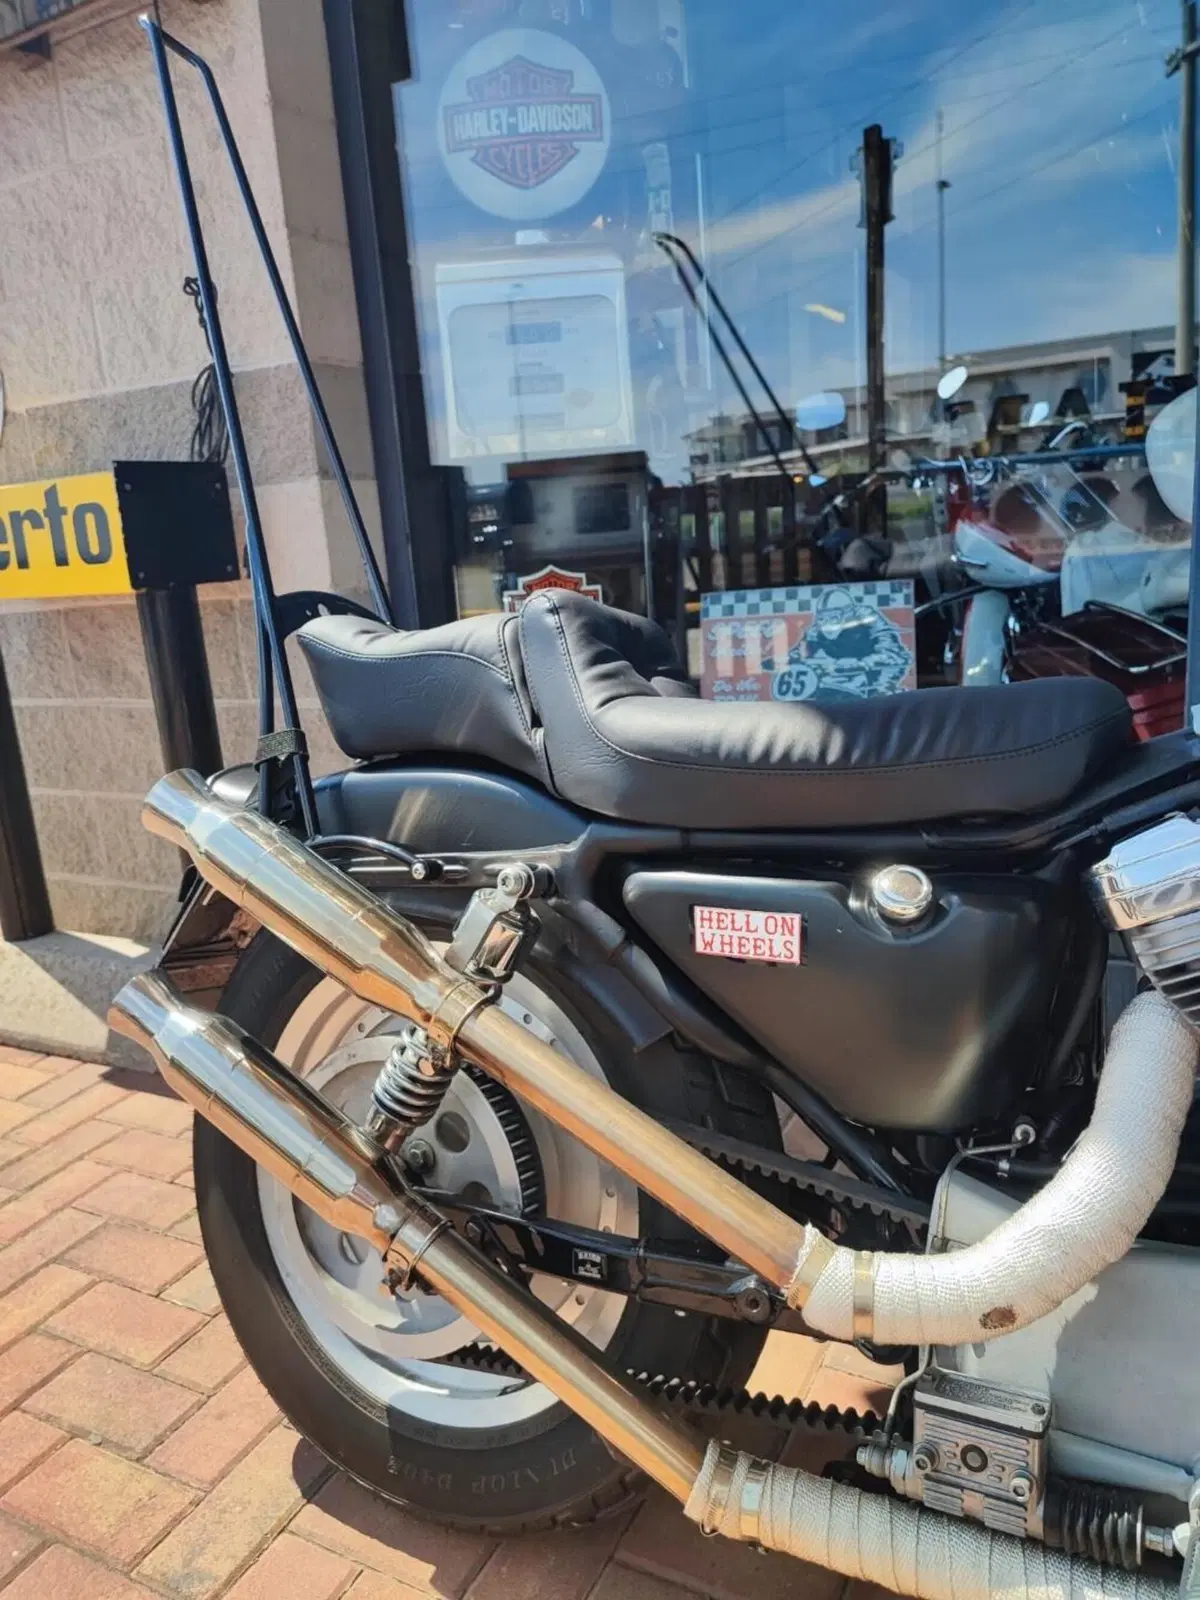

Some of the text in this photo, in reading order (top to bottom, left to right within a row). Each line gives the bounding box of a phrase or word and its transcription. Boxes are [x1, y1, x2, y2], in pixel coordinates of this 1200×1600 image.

[453, 104, 593, 141] HARLEY-DAVIDSON
[0, 483, 113, 572] rto
[777, 669, 810, 698] 65
[699, 909, 796, 937] HELL ON
[700, 932, 795, 960] WHEELS
